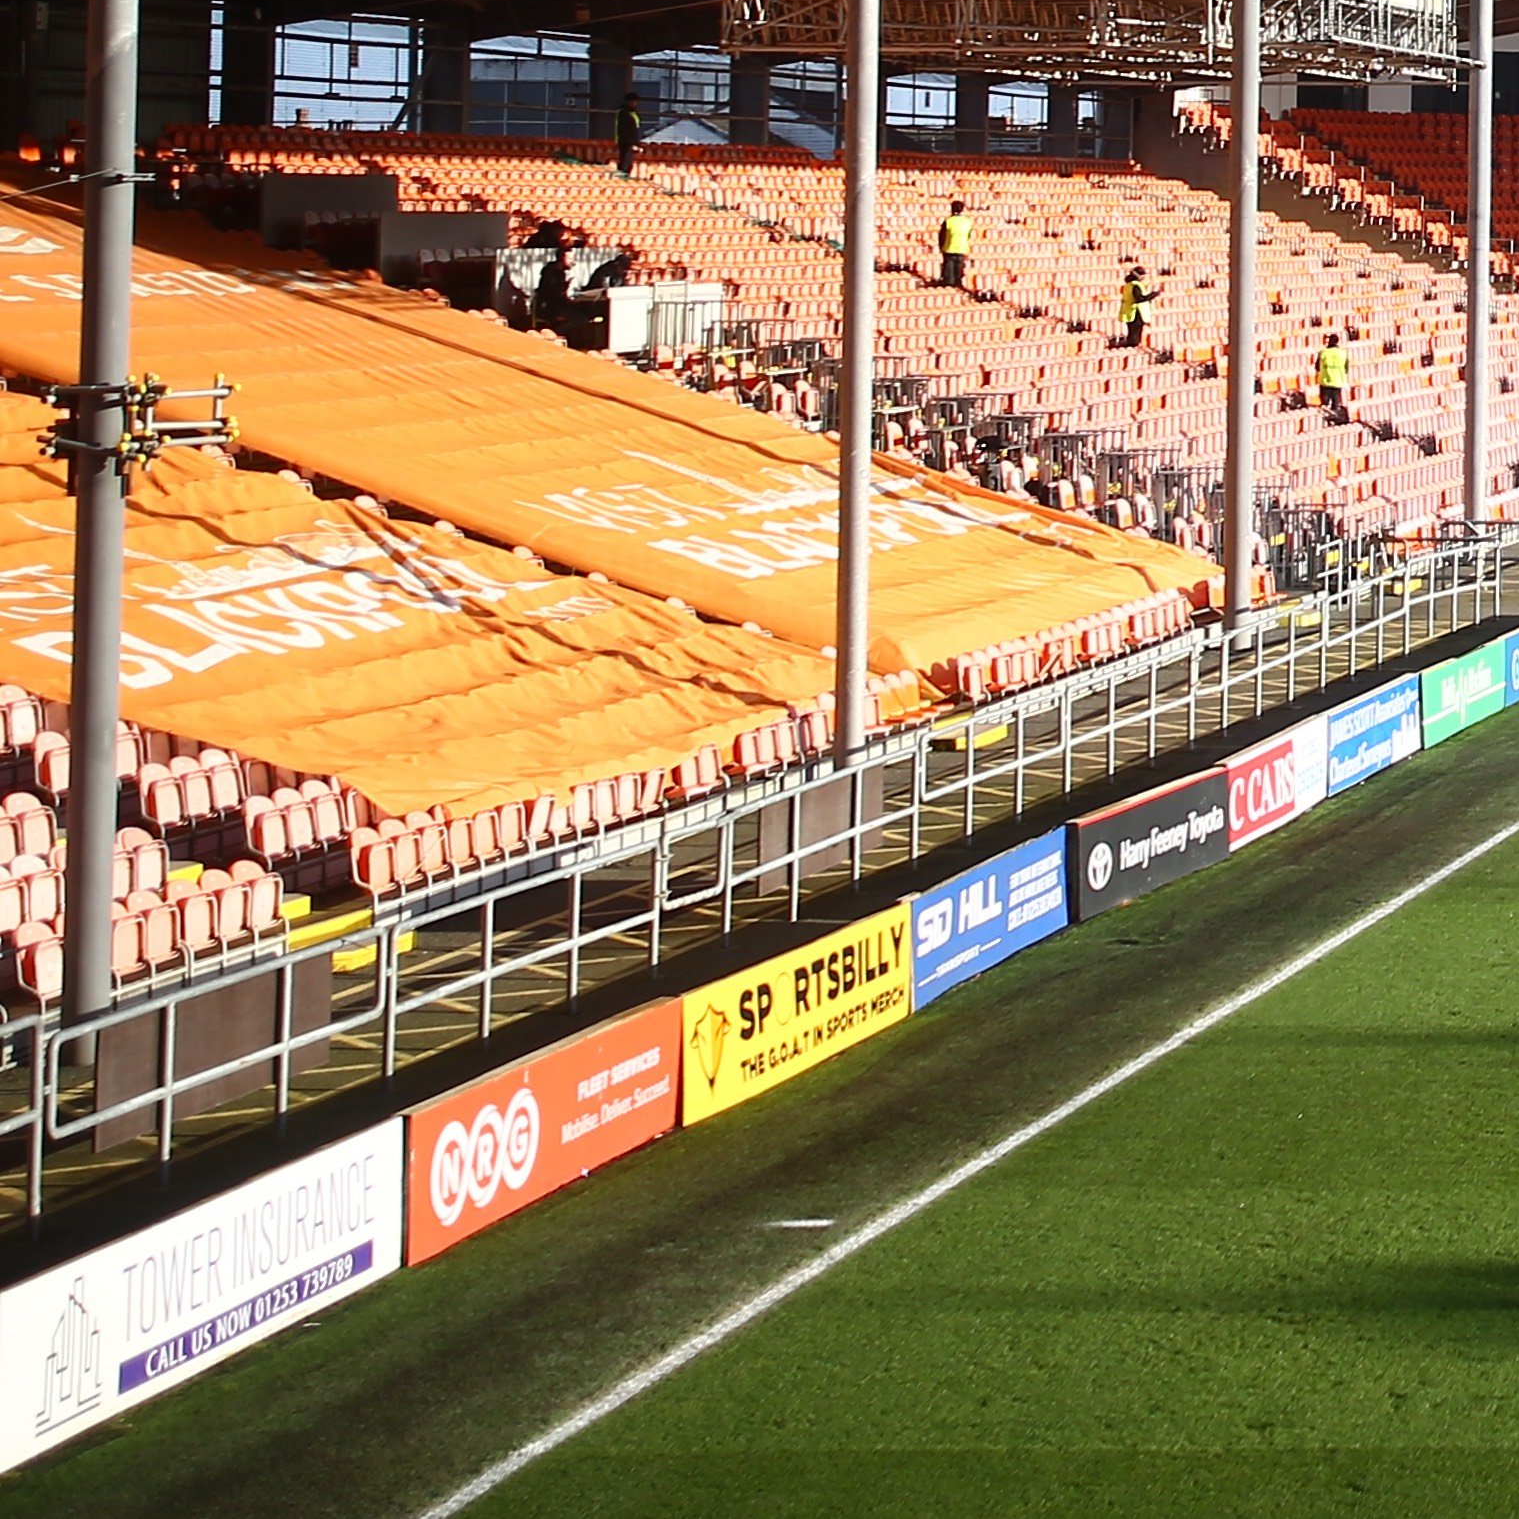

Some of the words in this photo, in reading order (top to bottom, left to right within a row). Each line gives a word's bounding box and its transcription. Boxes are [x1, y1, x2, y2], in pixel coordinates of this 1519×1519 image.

[1247, 752, 1295, 822] CABS
[1120, 838, 1150, 870] Harry
[1150, 821, 1188, 858] Feeney
[1187, 805, 1224, 844] Toyota
[958, 874, 1003, 934] HILL
[577, 1069, 609, 1102] FLEET
[611, 1046, 661, 1086] SERVICES
[741, 1051, 765, 1082] THE
[813, 1024, 824, 1047] IN
[827, 1003, 867, 1040] SPORTS
[870, 984, 905, 1016] MERCH
[437, 1109, 532, 1204] NRG
[122, 1227, 223, 1341] TOWER
[233, 1155, 374, 1285] INSURANCE
[145, 1341, 187, 1378] CALL
[192, 1325, 212, 1355] US
[216, 1306, 252, 1346] NOW
[255, 1281, 299, 1324] 01253
[302, 1254, 353, 1299] 739789
